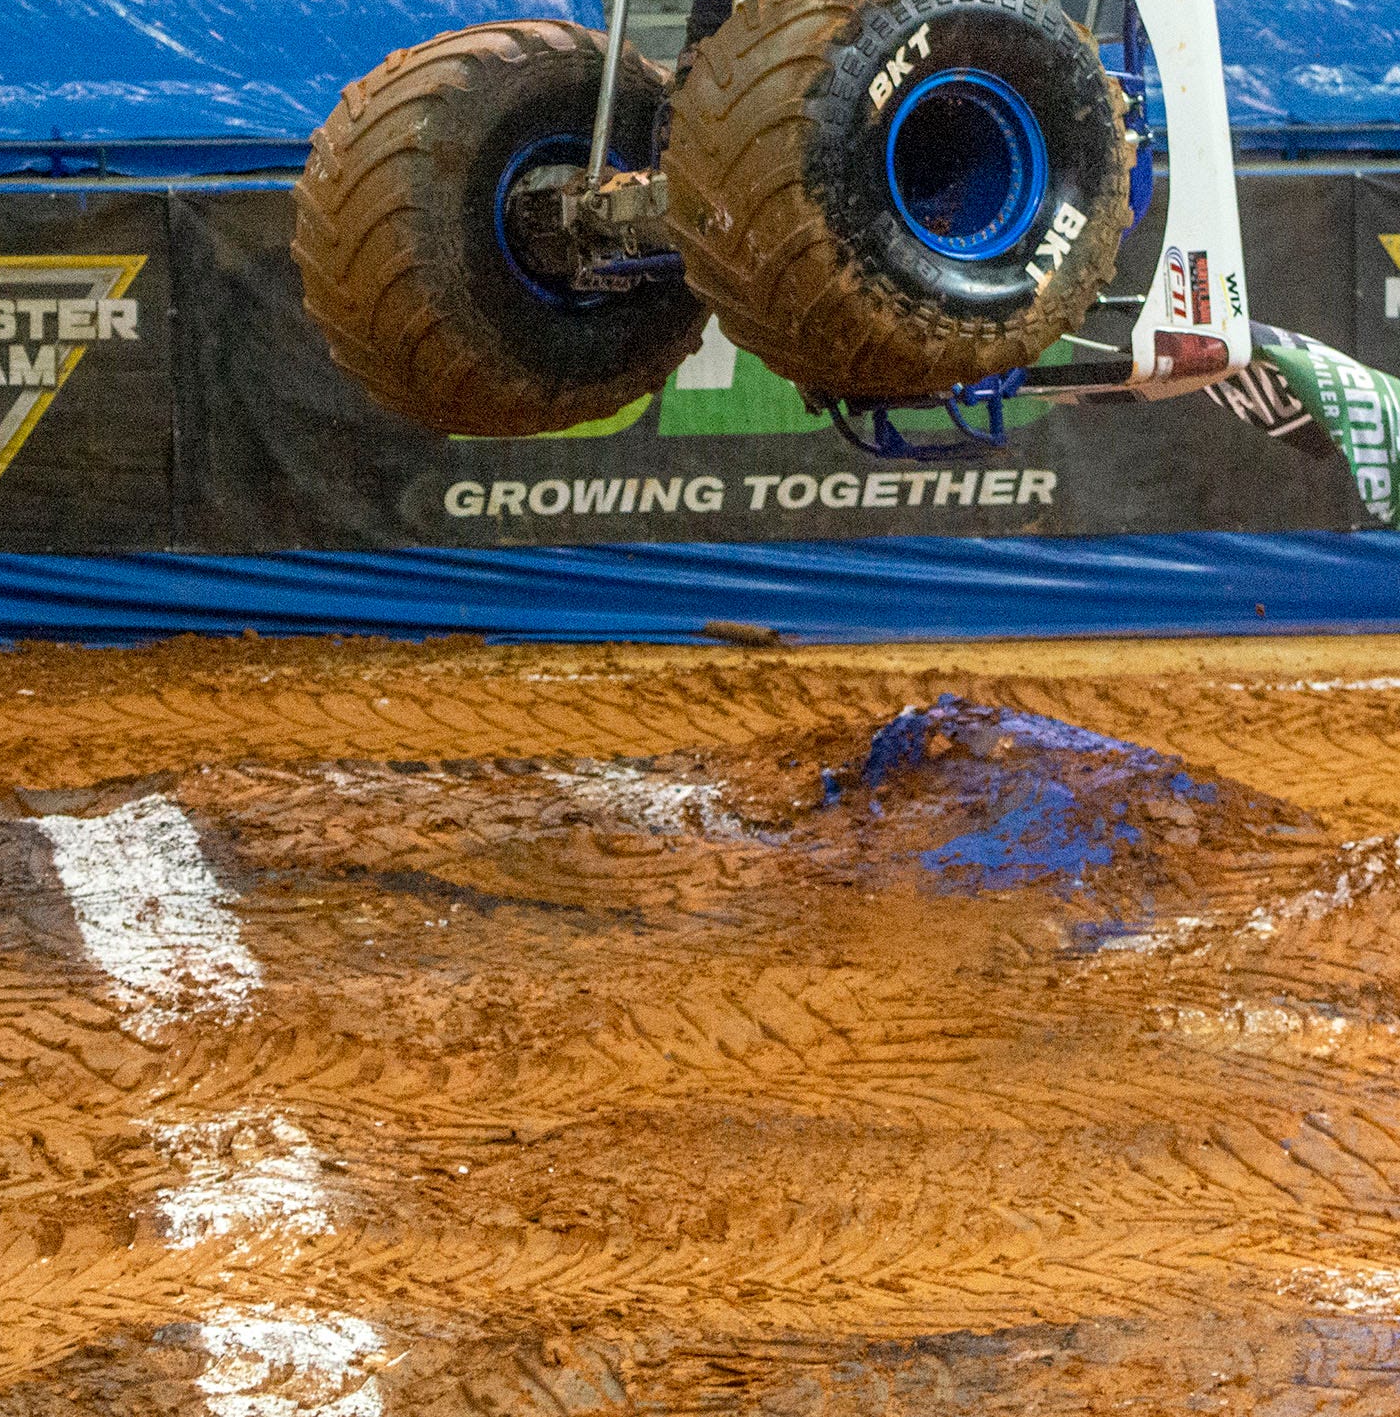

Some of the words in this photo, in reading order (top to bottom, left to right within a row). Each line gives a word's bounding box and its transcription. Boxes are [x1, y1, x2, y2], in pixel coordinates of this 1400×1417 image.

[868, 23, 932, 111] BKT
[1024, 202, 1088, 297] BKT
[1170, 262, 1187, 319] FTI
[1225, 272, 1243, 318] WIX
[442, 474, 726, 518] GROWING
[742, 469, 1057, 512] TOGETHER
